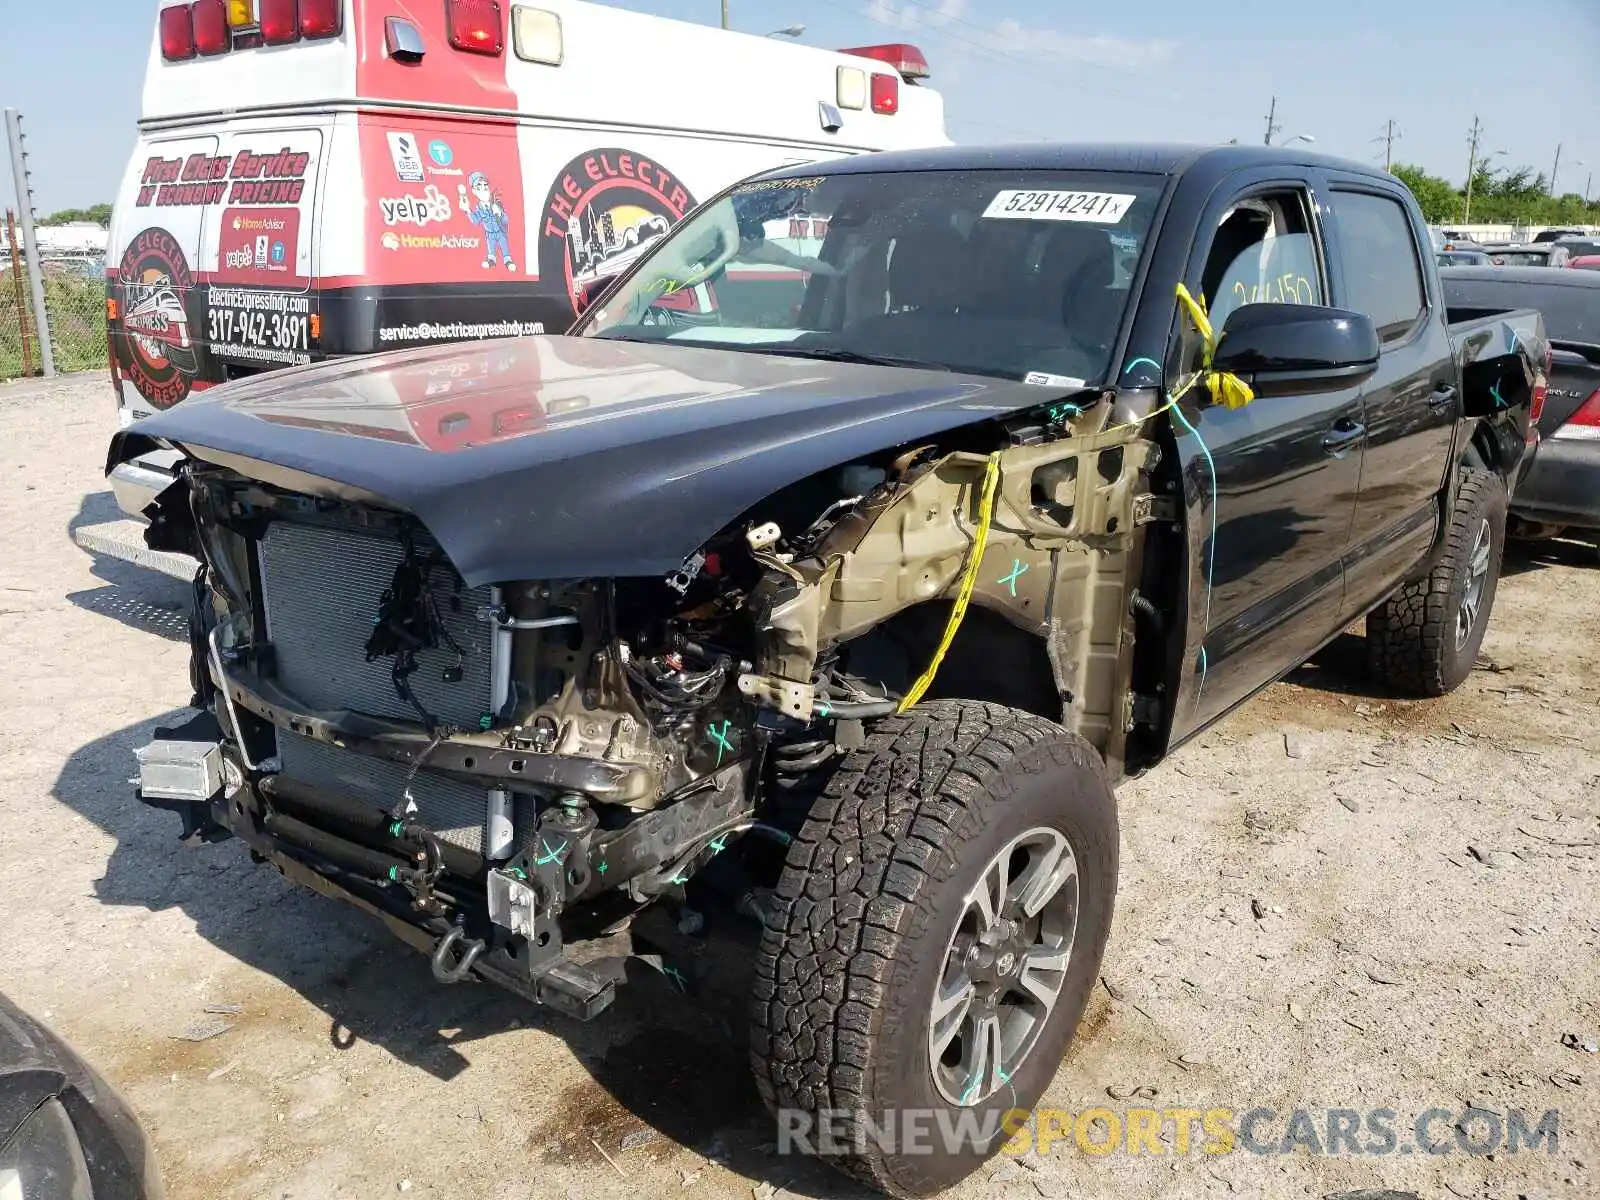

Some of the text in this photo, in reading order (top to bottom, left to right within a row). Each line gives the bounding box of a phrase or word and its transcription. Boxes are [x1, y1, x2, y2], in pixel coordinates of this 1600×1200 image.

[229, 147, 309, 178] Service
[156, 182, 229, 207] ECONOMY
[228, 179, 305, 204] PRICING
[1005, 192, 1113, 216] 52914241
[383, 198, 428, 222] yelp
[545, 174, 582, 238] THE
[242, 218, 286, 230] HomeAdvisor
[400, 234, 480, 249] HomeAdvisor
[227, 249, 244, 267] yelp
[208, 287, 309, 315] ElectricExpressIndy.com
[208, 308, 308, 350] 317-942-3691
[379, 320, 545, 341] service@electricexpressindy.com
[210, 343, 311, 366] service@electricexpressindy.com
